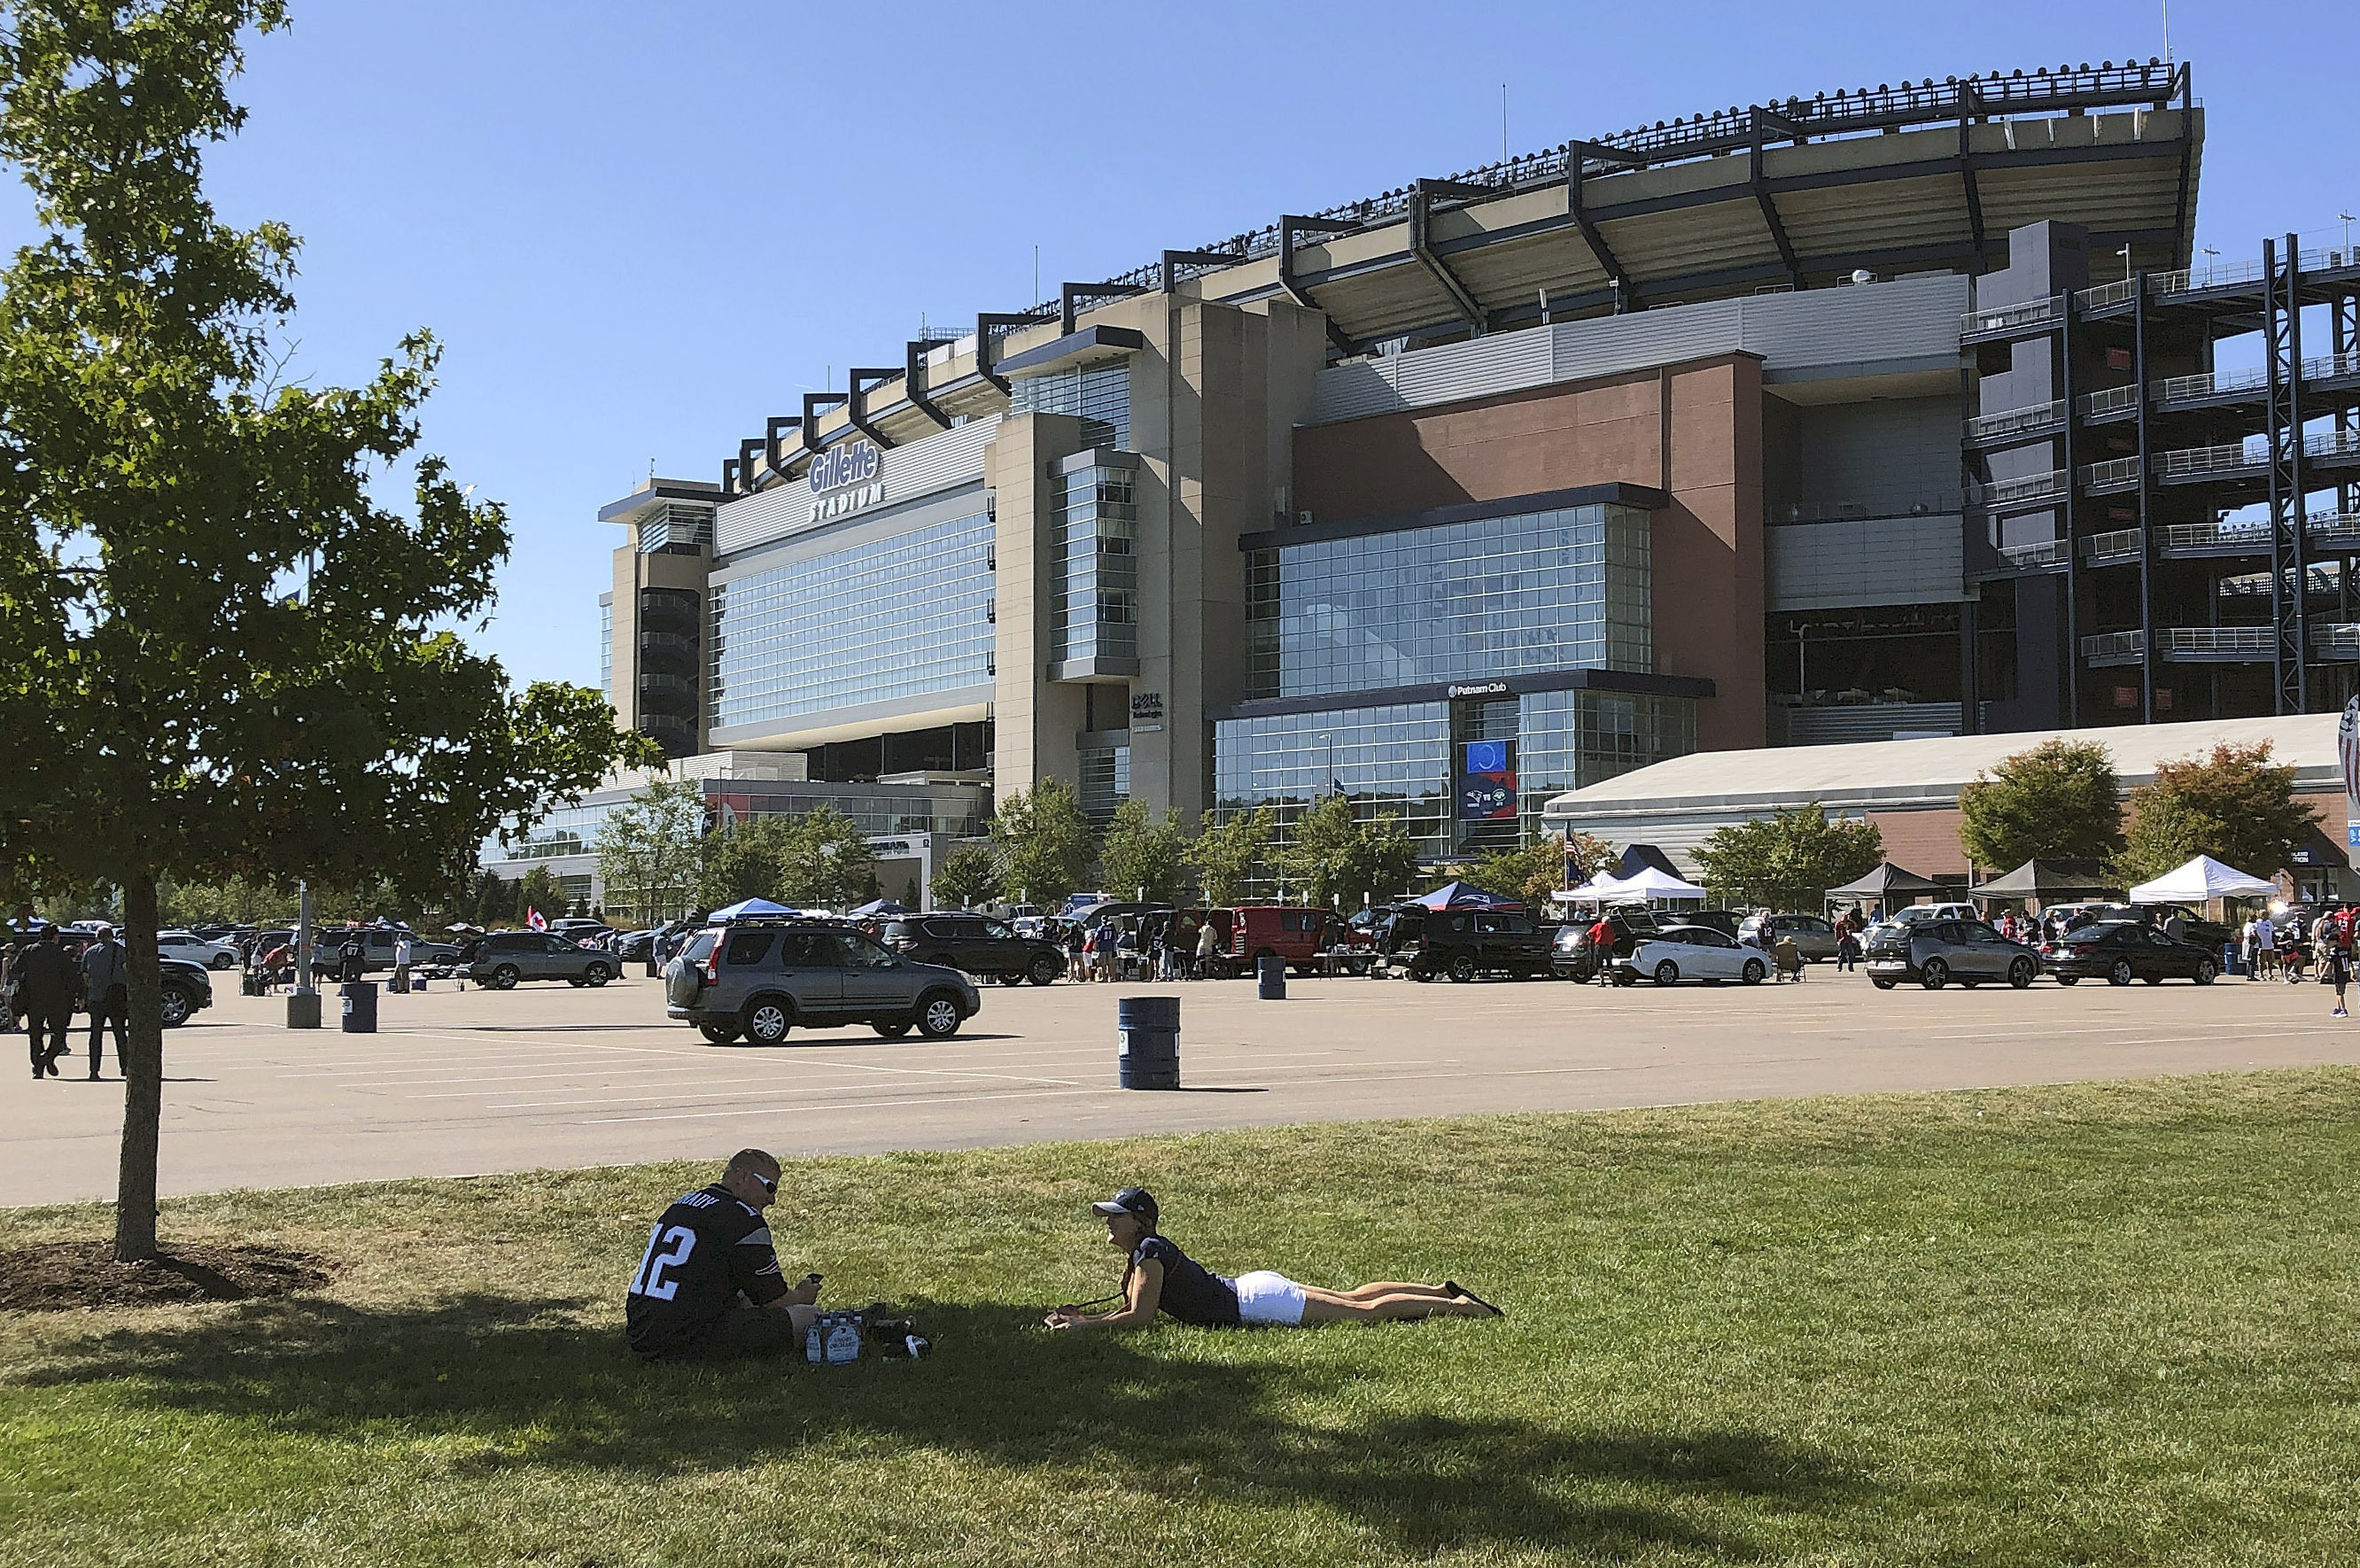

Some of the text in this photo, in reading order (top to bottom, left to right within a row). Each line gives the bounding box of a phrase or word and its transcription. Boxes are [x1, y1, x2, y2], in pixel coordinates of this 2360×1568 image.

[810, 439, 879, 493] Gillette
[808, 482, 883, 523] STADIUM
[1457, 682, 1506, 695] Putnam Club
[1764, 927, 1773, 936] 12
[630, 1223, 696, 1301] 12
